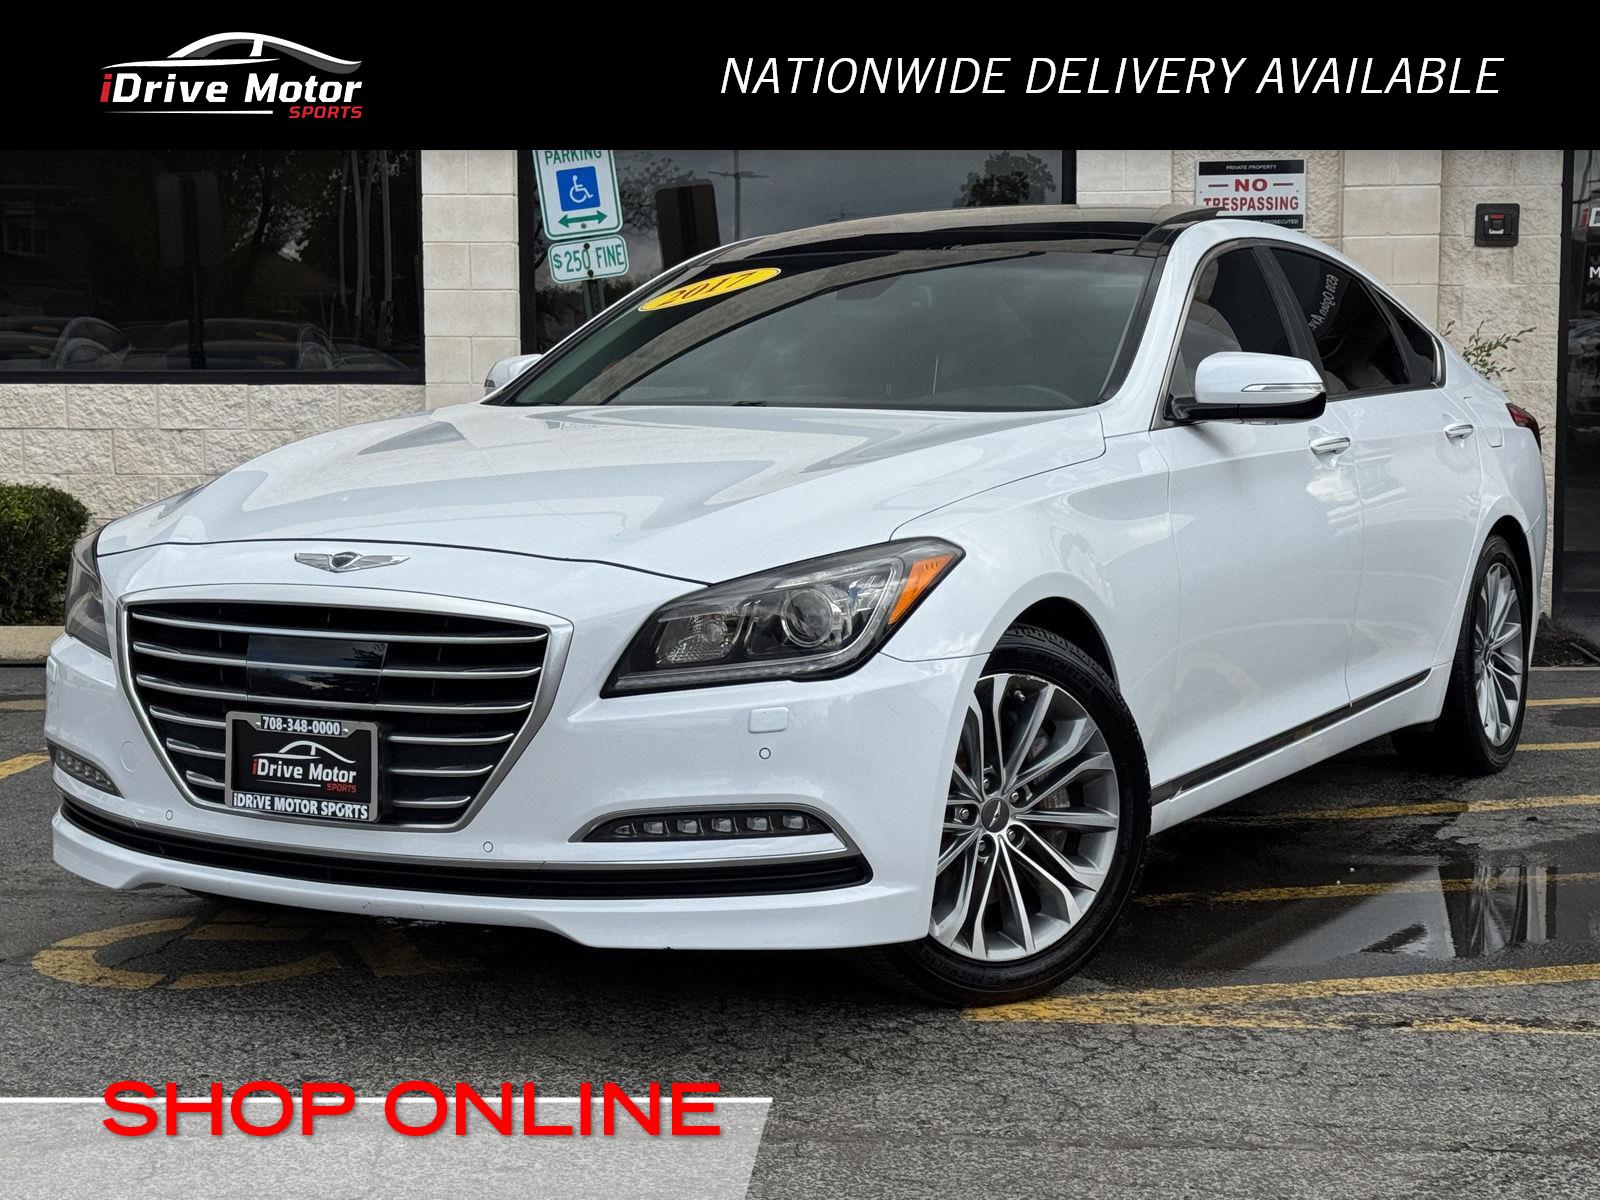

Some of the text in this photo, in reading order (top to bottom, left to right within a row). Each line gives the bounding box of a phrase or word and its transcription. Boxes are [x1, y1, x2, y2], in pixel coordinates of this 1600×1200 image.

[544, 150, 602, 166] PARKING
[1234, 178, 1268, 192] NO
[1203, 196, 1299, 212] TRESPASSING
[595, 244, 625, 269] FINE
[656, 271, 760, 308] 2017
[262, 716, 341, 736] 708-348-0000
[251, 758, 357, 784] iDrive Motor
[326, 783, 357, 793] SPORTS
[274, 798, 318, 815] MOTOR
[320, 801, 368, 819] SPORTS
